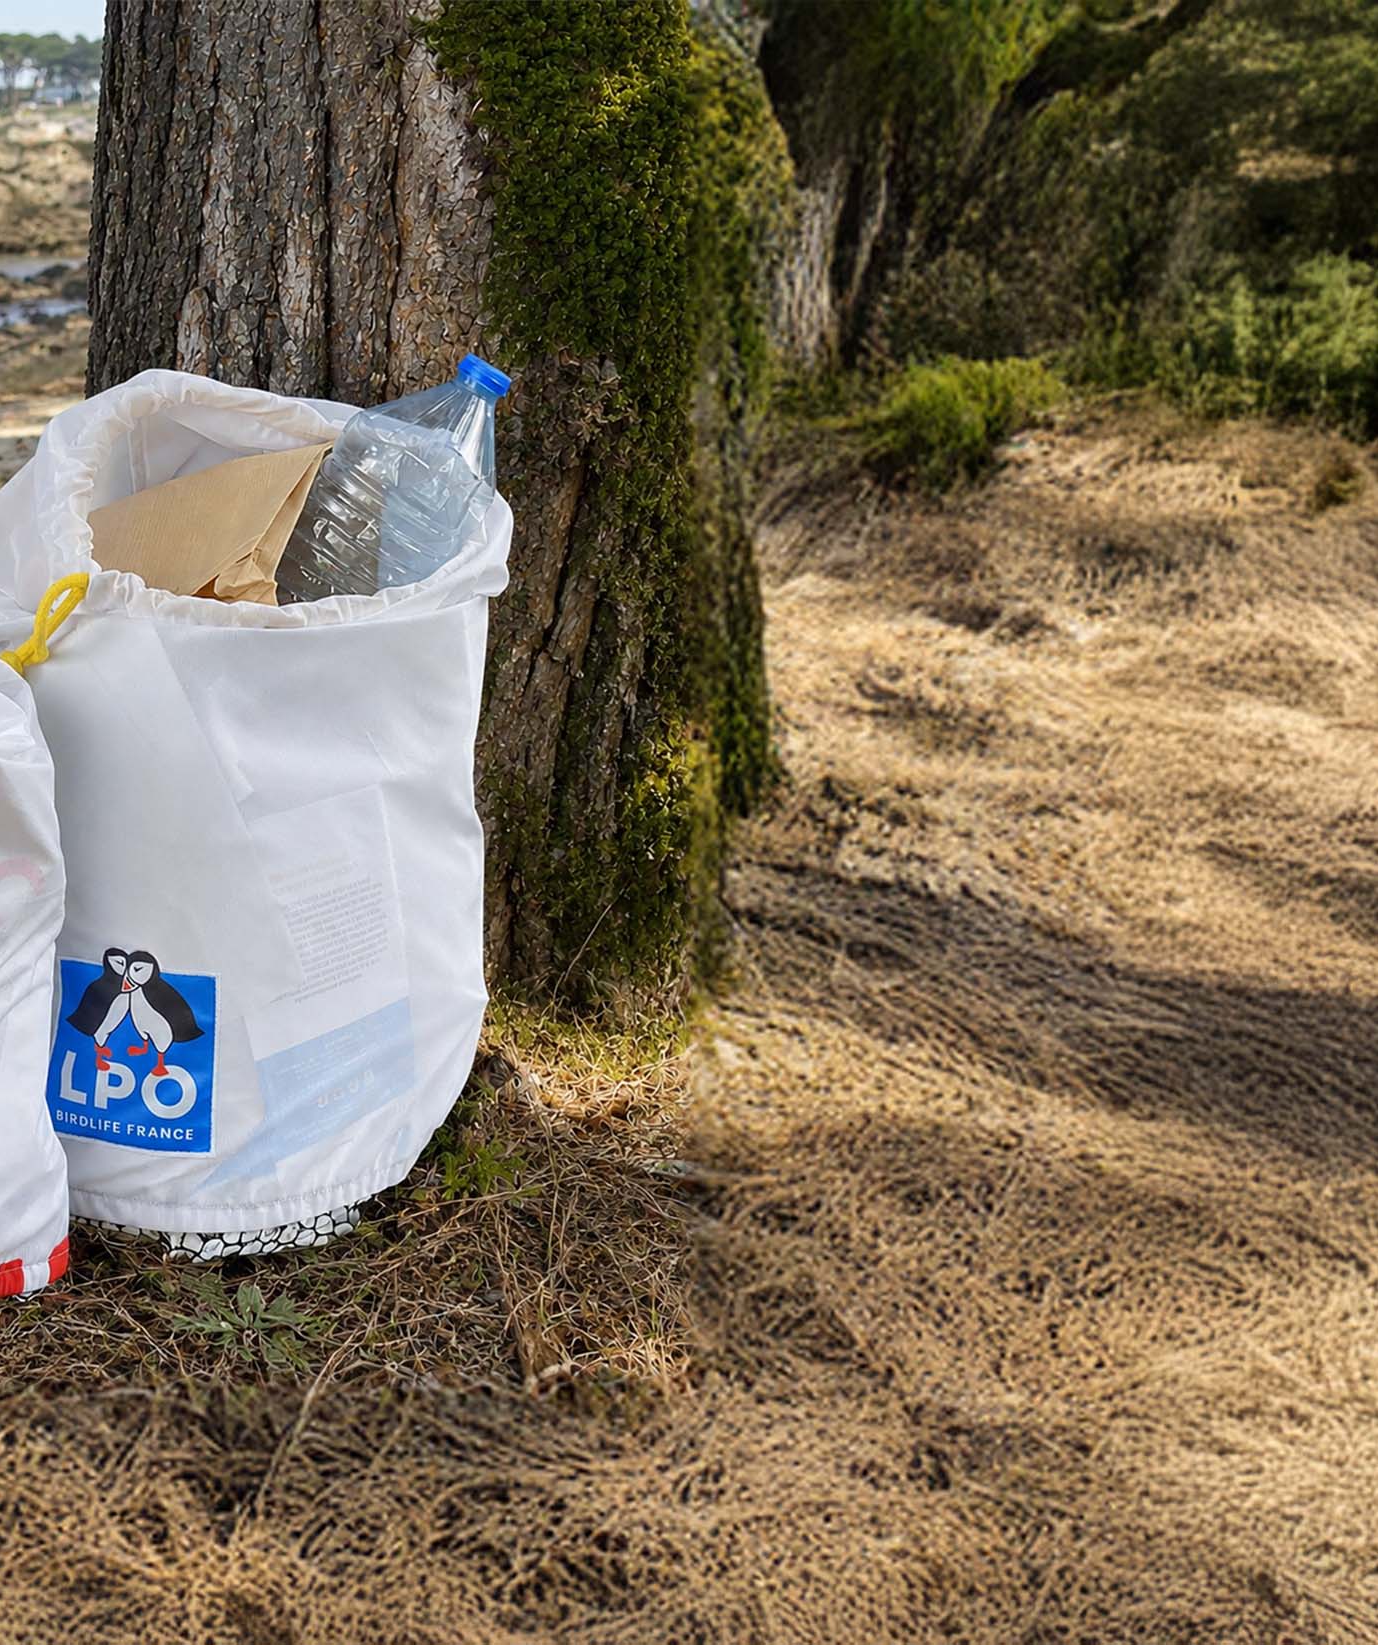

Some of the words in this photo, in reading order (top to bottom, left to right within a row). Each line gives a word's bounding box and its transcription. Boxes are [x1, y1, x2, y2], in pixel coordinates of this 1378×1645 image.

[60, 1051, 197, 1119] LPO
[56, 1109, 121, 1134] BIRDLIFE
[126, 1124, 194, 1141] FRANCE
